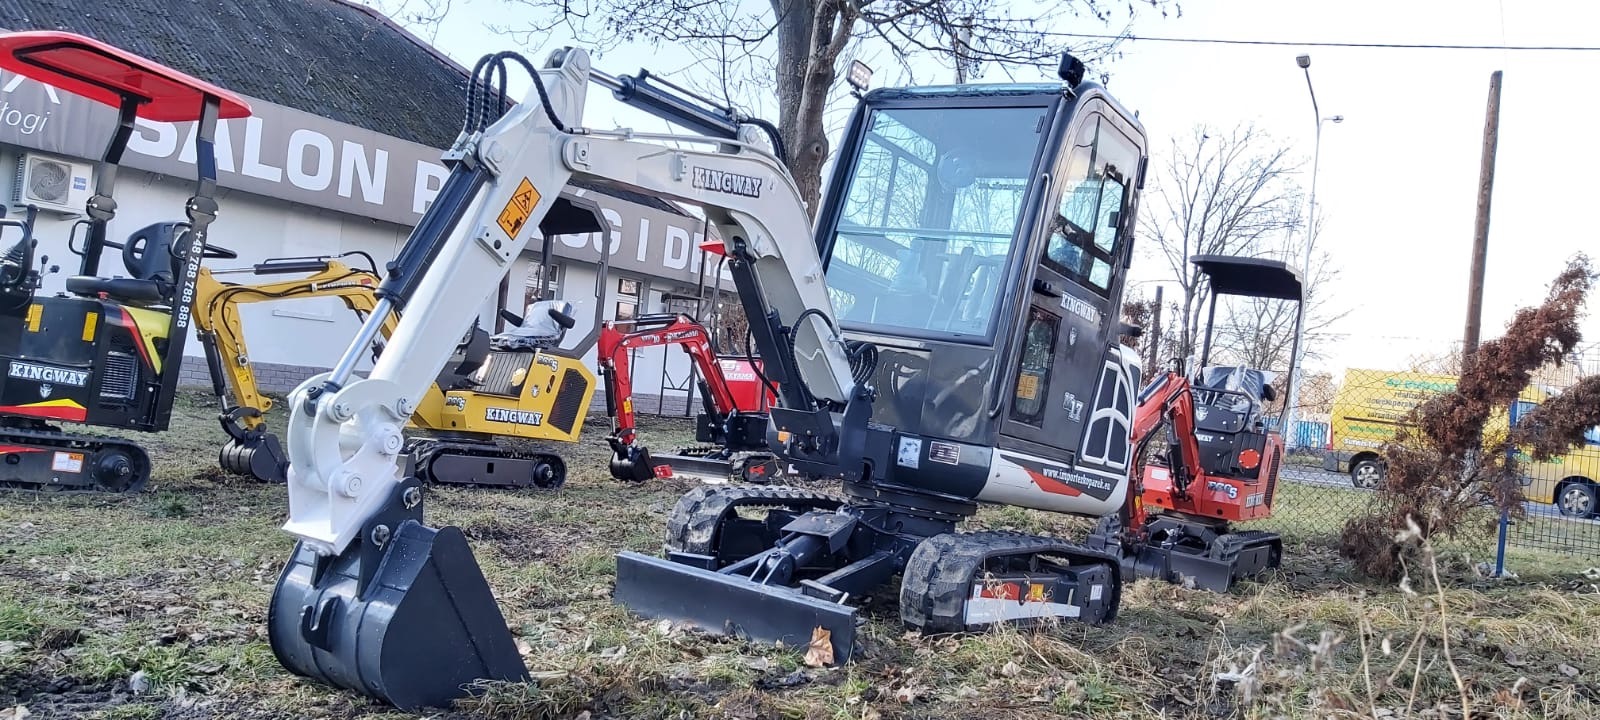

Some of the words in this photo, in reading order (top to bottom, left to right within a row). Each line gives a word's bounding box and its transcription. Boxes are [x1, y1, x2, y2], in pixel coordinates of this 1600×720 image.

[693, 166, 762, 198] KINGWAY
[192, 230, 204, 254] +48
[187, 256, 199, 279] 788
[182, 280, 194, 303] 788
[177, 305, 190, 328] 888
[1060, 292, 1097, 322] KINGWAY
[8, 361, 90, 387] KINGWAY
[485, 407, 543, 426] KINGWAY
